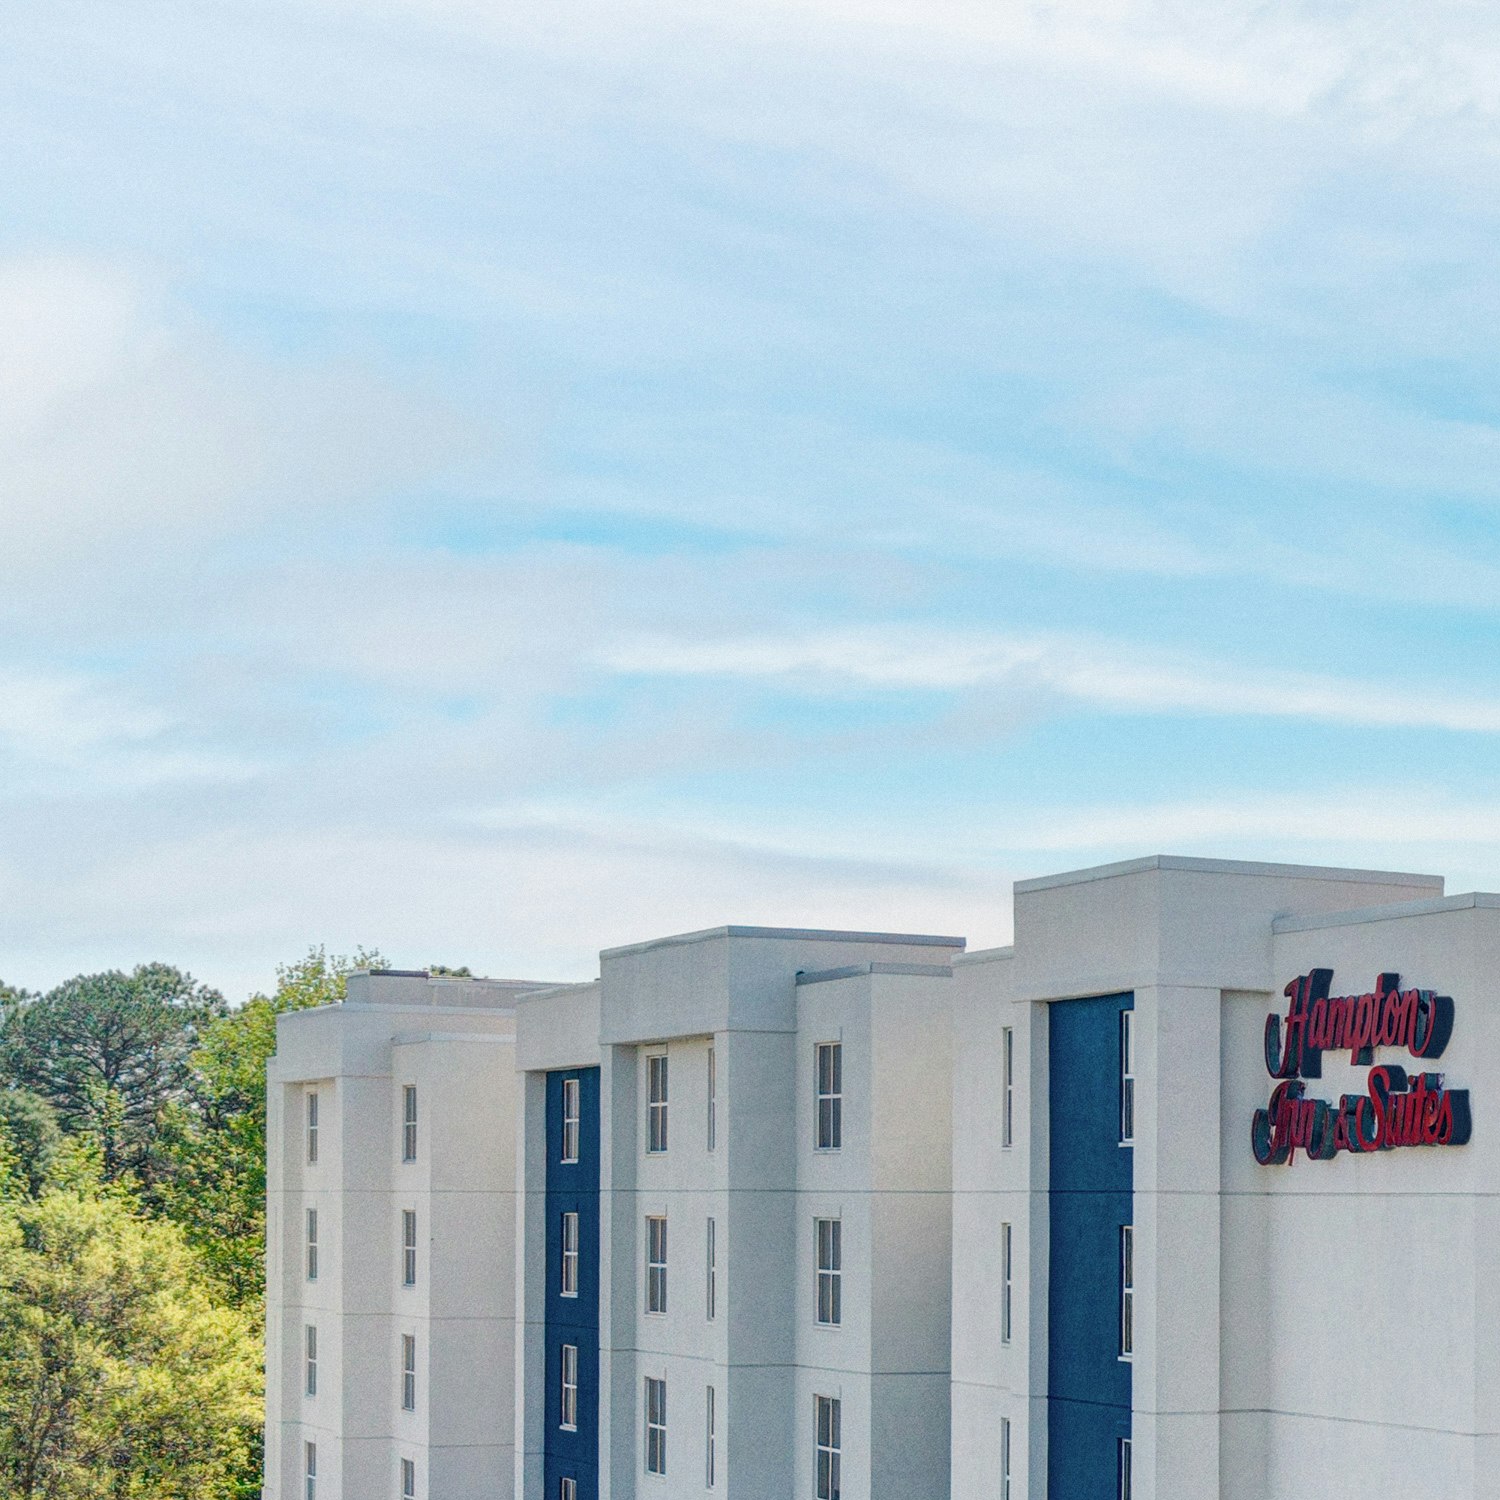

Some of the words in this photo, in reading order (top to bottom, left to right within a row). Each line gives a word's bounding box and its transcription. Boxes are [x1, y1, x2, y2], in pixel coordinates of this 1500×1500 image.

[1265, 968, 1455, 1079] Hampton
[1252, 1081, 1336, 1165] Inn
[1356, 1066, 1472, 1152] Suites
